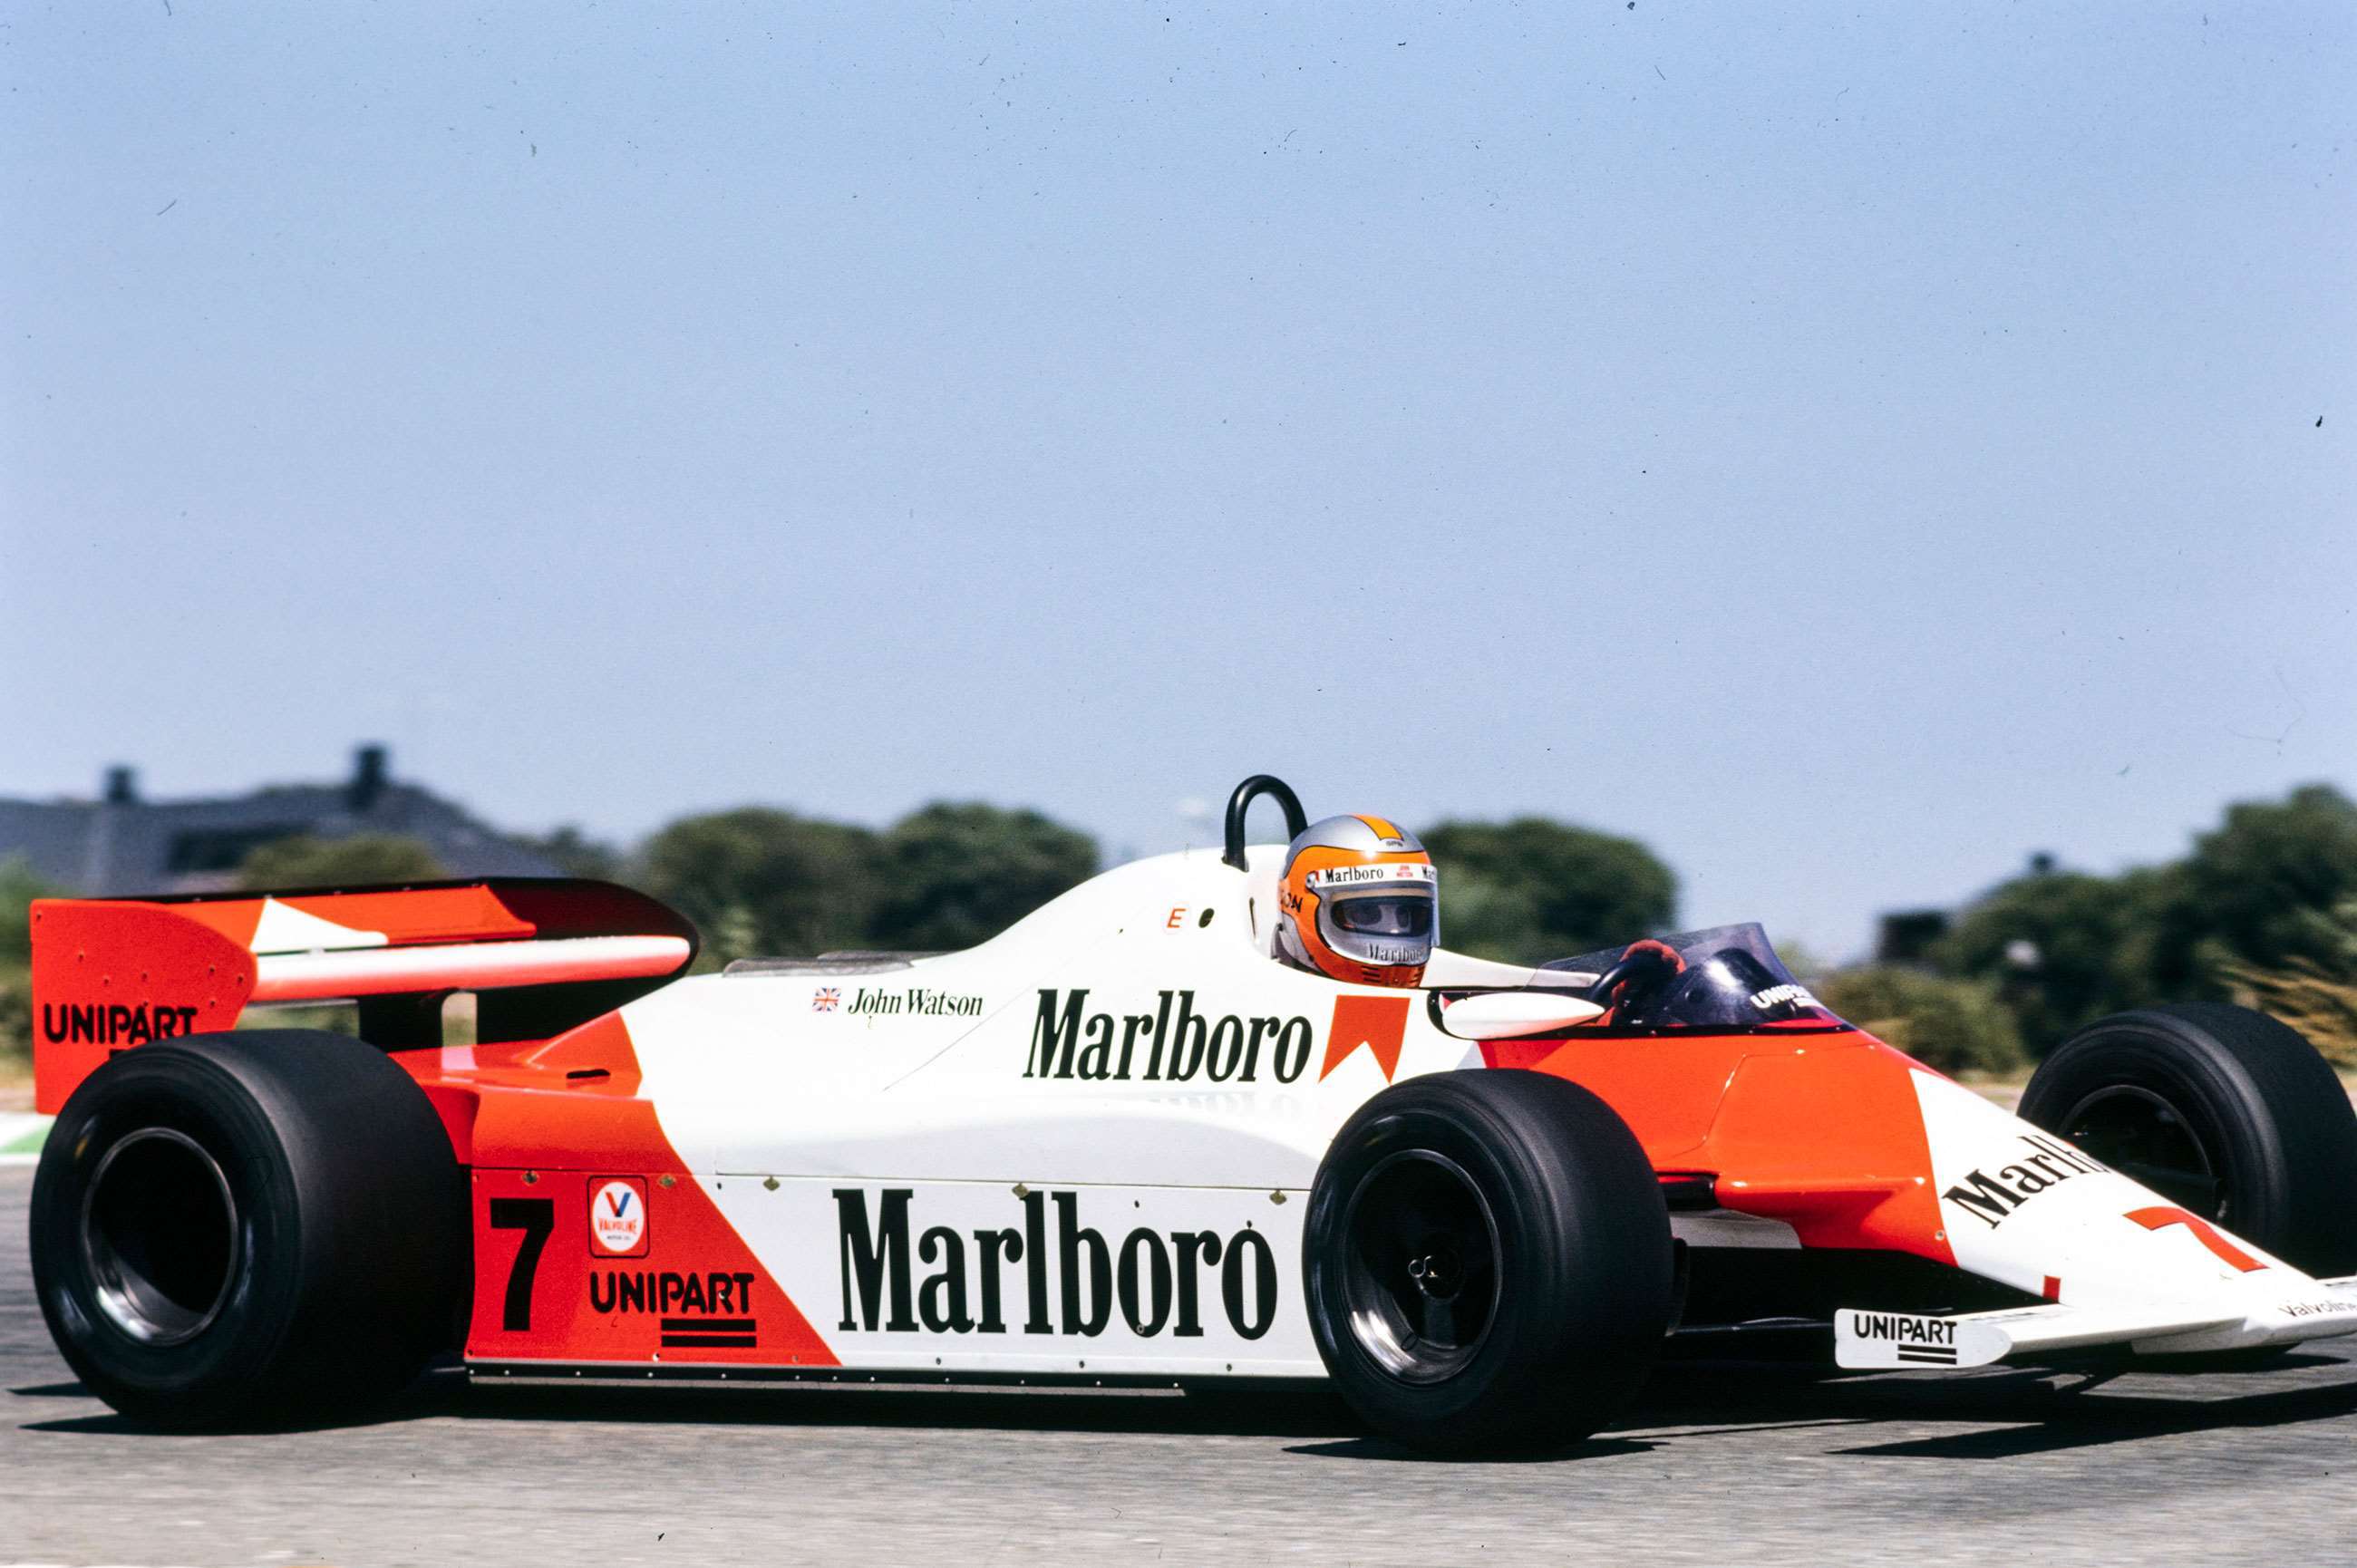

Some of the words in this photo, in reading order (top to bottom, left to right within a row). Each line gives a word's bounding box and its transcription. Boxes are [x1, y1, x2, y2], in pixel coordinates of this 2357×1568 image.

[1325, 867, 1384, 883] Marlboro
[1167, 908, 1187, 928] E
[848, 988, 902, 1014] John
[907, 989, 984, 1016] Watson
[44, 1003, 198, 1044] UNIPART
[1023, 989, 1313, 1084] Marlboro
[490, 1198, 555, 1331] 7
[832, 1188, 1278, 1341] Marlboro
[590, 1271, 755, 1314] UNIPART
[1855, 1314, 1957, 1344] UNIPART
